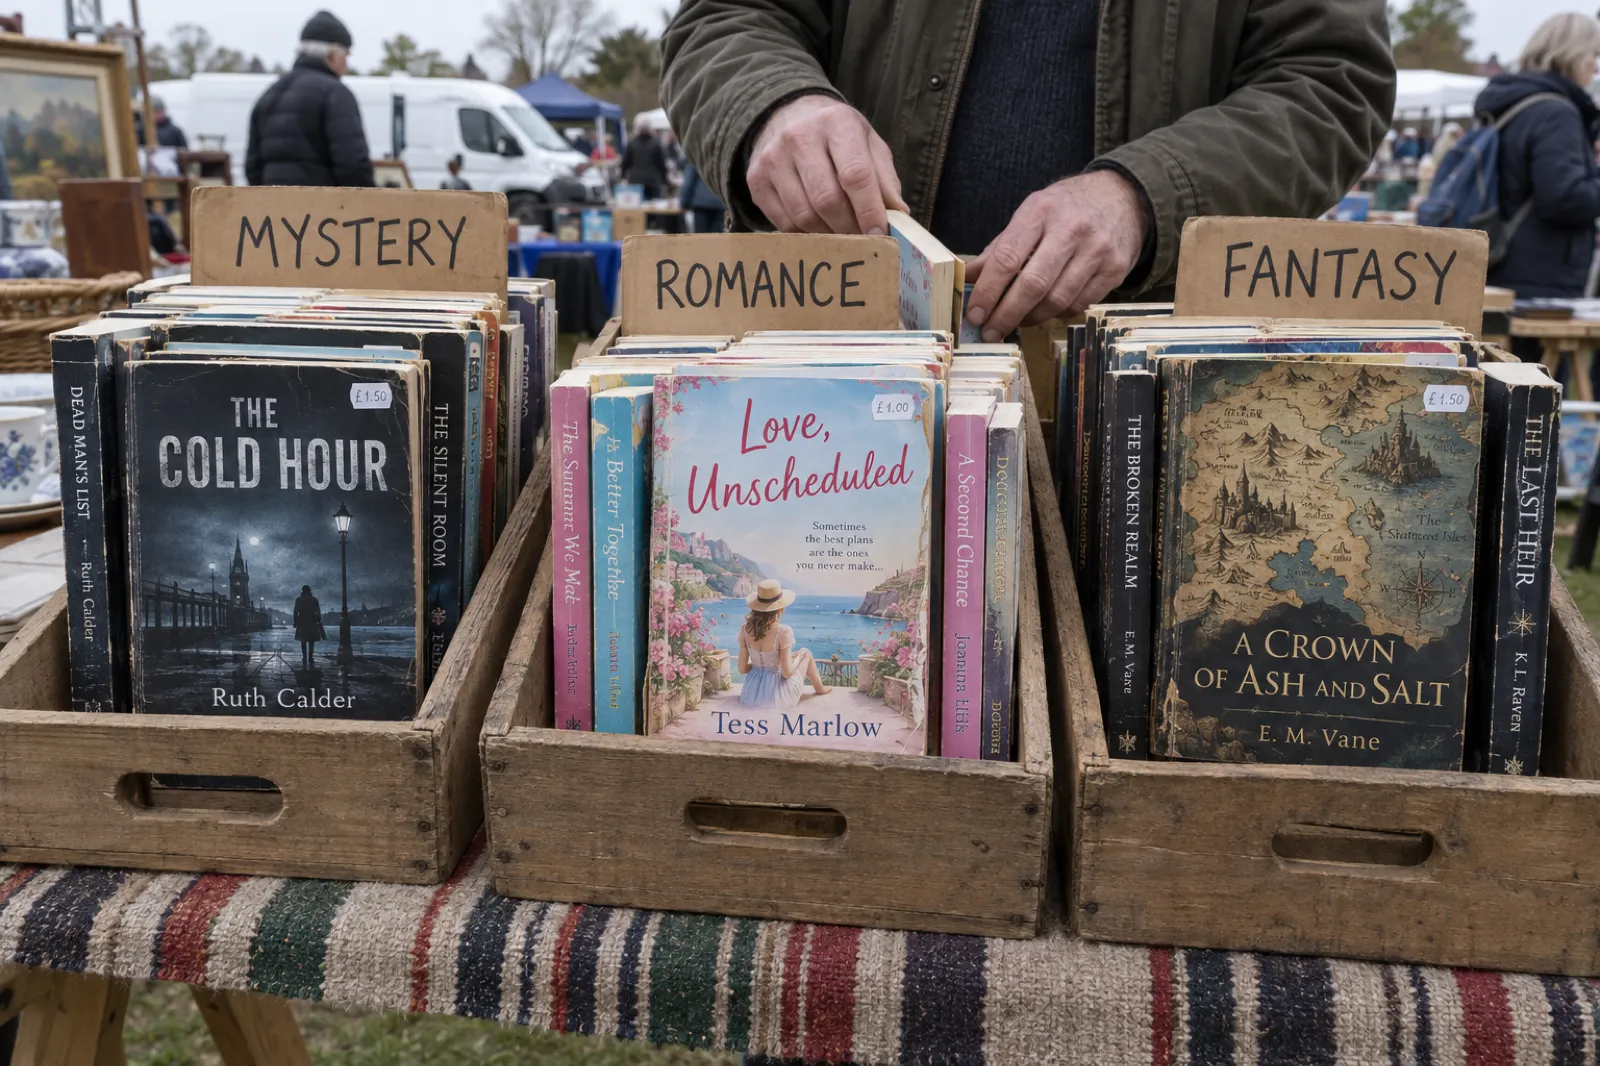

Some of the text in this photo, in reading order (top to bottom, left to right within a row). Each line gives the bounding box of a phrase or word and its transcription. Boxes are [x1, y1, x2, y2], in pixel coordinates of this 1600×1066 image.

[236, 214, 467, 270] MYSTERY
[656, 258, 866, 310] ROMANCE
[1225, 241, 1458, 305] FANTASY
[355, 388, 387, 404] £1.50
[876, 400, 909, 414] £1.00
[1428, 391, 1464, 405] £1.50
[231, 397, 277, 429] THE
[741, 397, 830, 454] Love,
[70, 386, 91, 520] DEAD MAN'S LIST
[562, 421, 579, 455] The
[159, 435, 389, 492] COLD HOUR
[687, 443, 913, 514] Unscheduled
[433, 403, 449, 567] THE SILENT ROOM
[607, 459, 624, 518] Better
[1514, 414, 1545, 589] THE LAST HEIR
[1124, 415, 1142, 589] THE BROKEN REALM
[812, 521, 867, 531] Sometimes
[956, 452, 975, 608] A Second Chance
[1416, 514, 1441, 527] The
[564, 534, 581, 563] We
[805, 534, 874, 546] the best plans
[809, 549, 824, 557] are
[828, 548, 843, 557] the
[1417, 549, 1426, 560] N
[796, 561, 883, 572] you never make...
[81, 562, 96, 642] Ruth Calder
[1233, 632, 1255, 655] A
[212, 687, 356, 711] Ruth Calder
[1194, 667, 1228, 689] OF
[1315, 678, 1366, 700] AND
[711, 712, 883, 739] Tess Marlow
[1510, 687, 1525, 732] Raven
[1258, 725, 1380, 752] E. M. Vane
